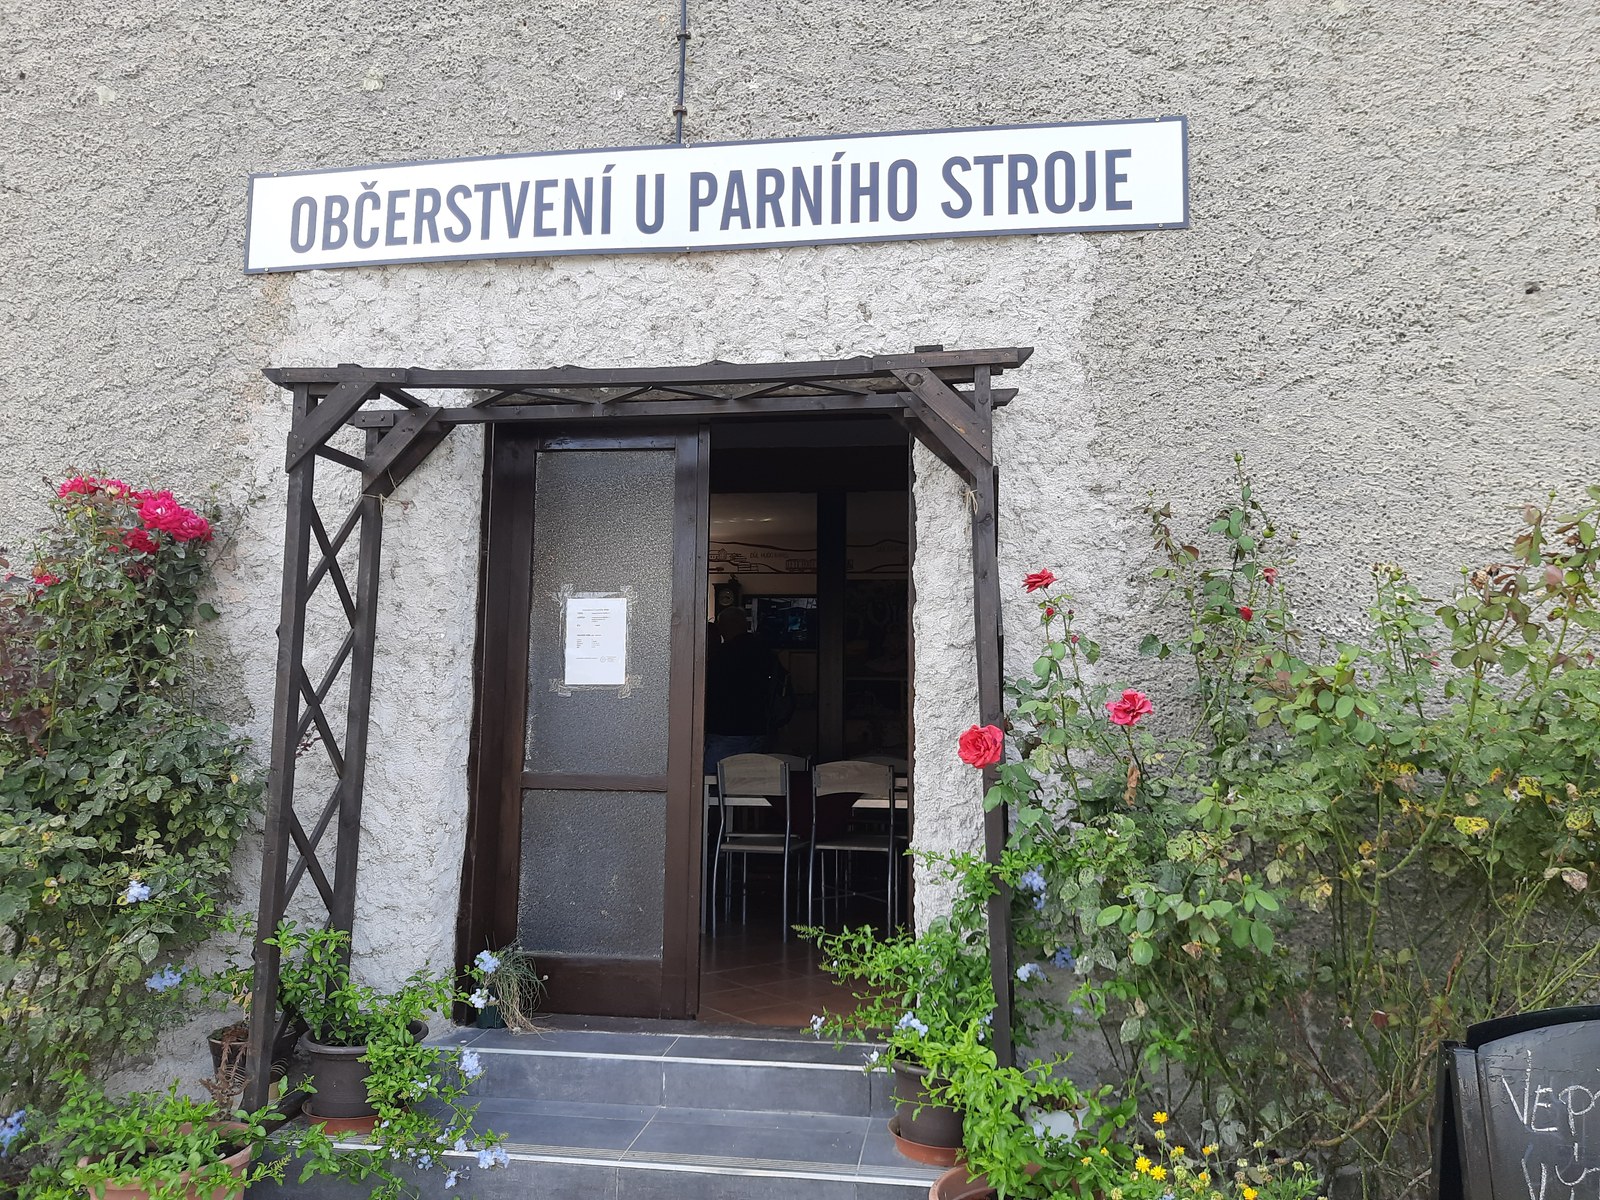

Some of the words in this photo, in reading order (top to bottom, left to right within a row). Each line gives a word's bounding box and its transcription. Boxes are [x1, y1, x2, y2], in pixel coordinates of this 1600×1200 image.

[290, 163, 616, 254] OBČERSTVENÍ
[635, 173, 665, 235] U
[689, 151, 918, 232] PARNÍHO
[940, 148, 1133, 219] STROJE
[1501, 1049, 1600, 1137] VEP
